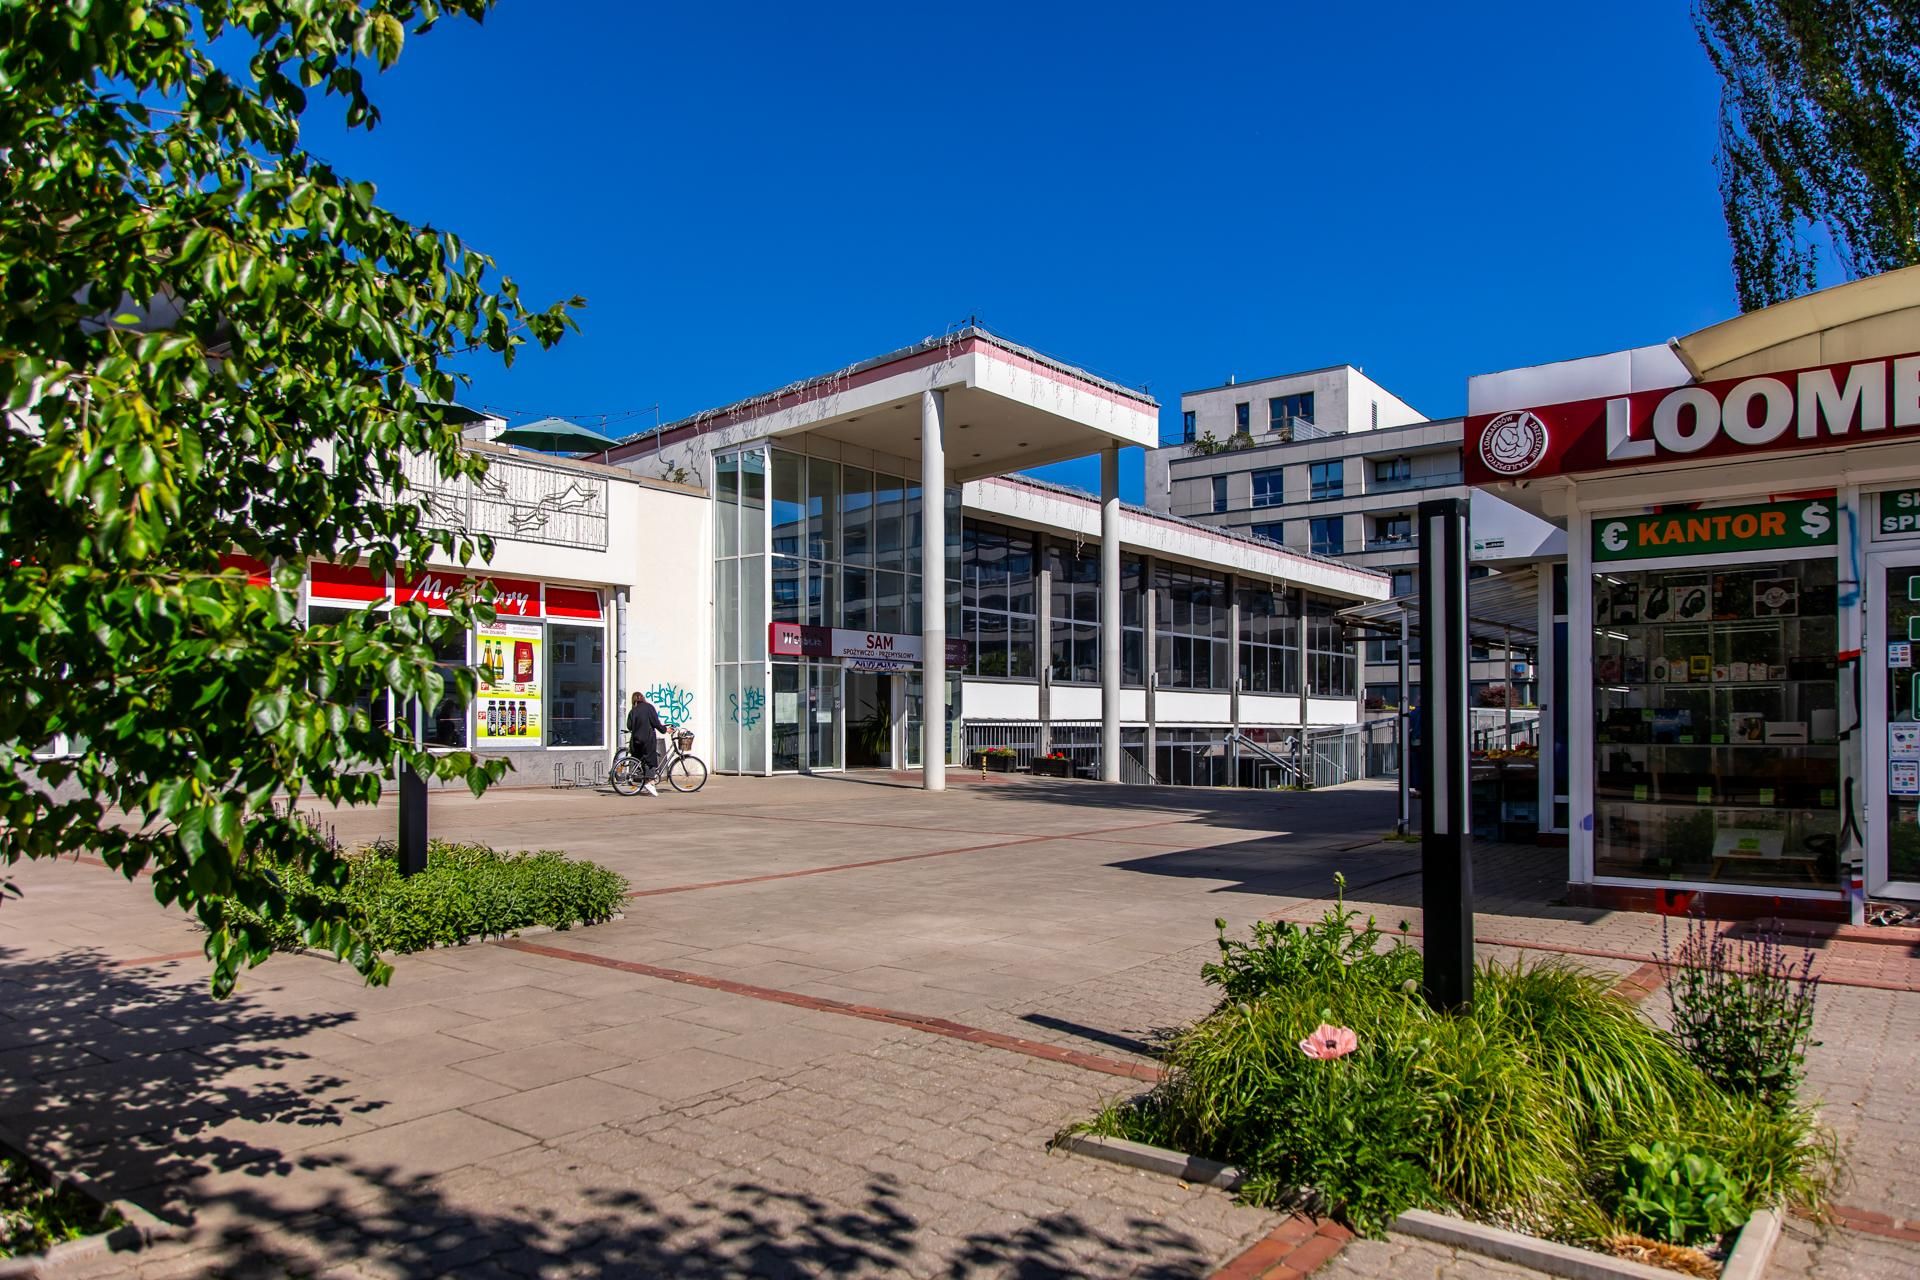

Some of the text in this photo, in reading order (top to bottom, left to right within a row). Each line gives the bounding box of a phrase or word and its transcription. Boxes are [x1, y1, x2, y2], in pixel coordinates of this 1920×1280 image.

[1529, 421, 1543, 459] ZRZESZENIE
[1486, 453, 1529, 471] NAJLEPSZYCH
[1638, 511, 1787, 546] KANTOR
[1882, 514, 1920, 531] SP
[409, 574, 529, 615] Meury
[866, 634, 894, 650] SAM
